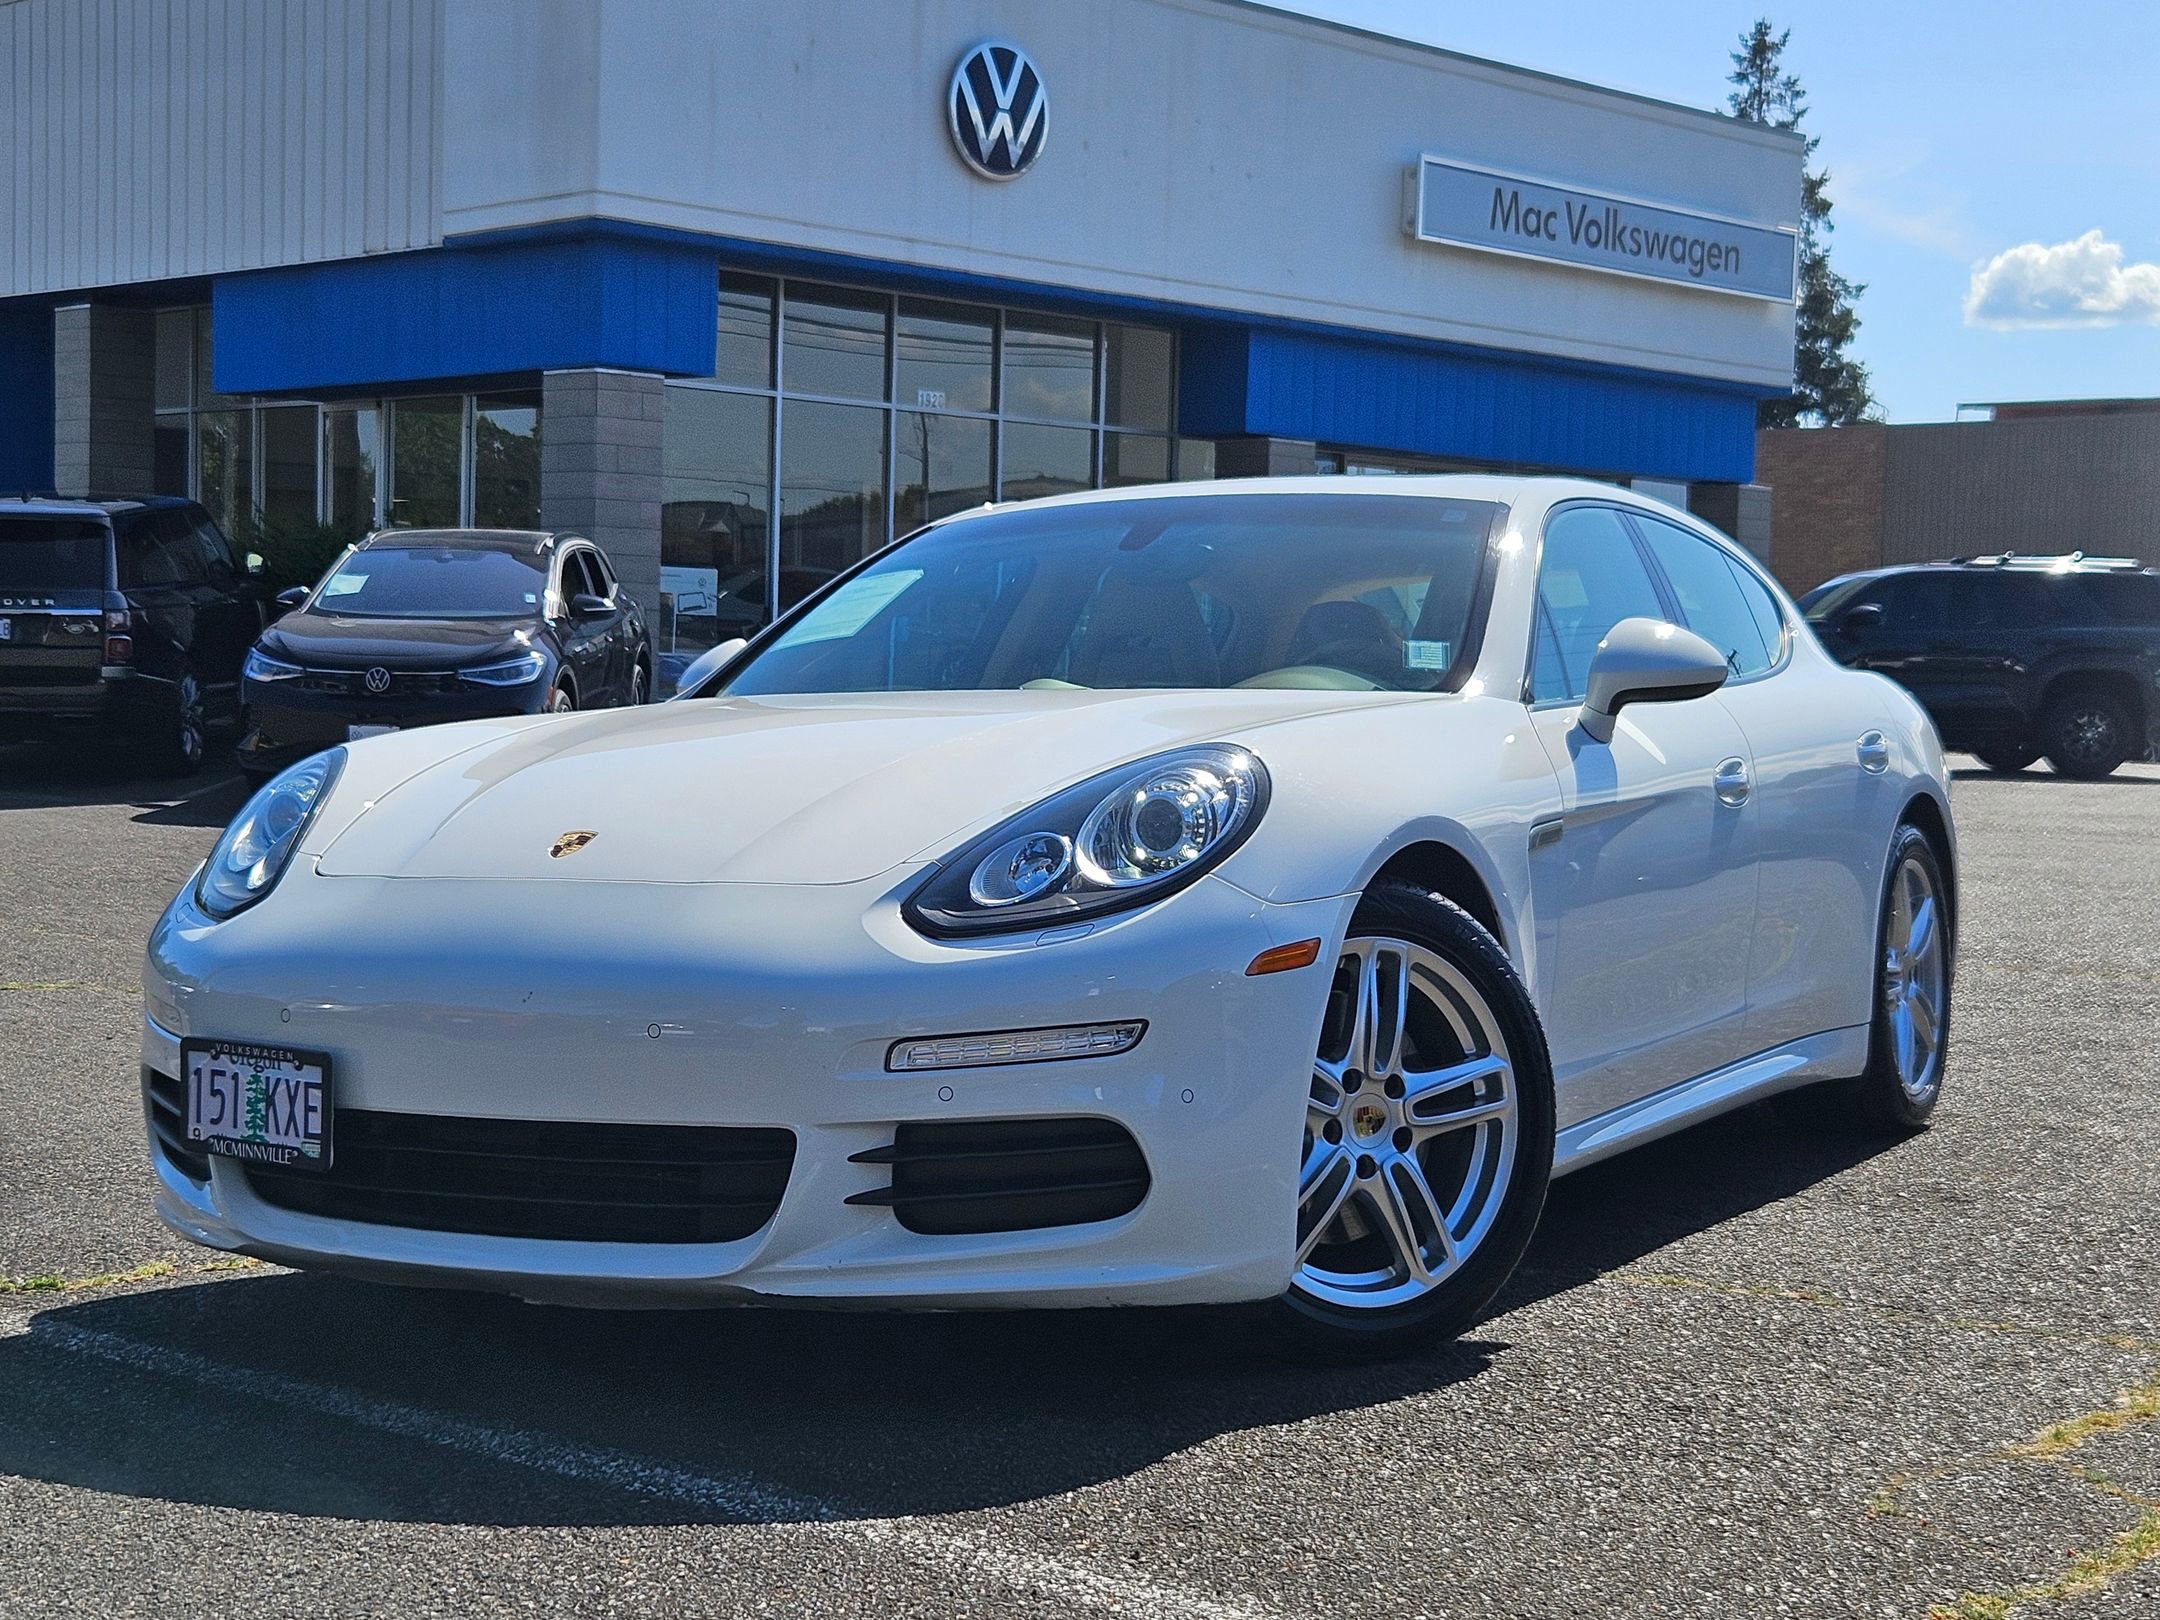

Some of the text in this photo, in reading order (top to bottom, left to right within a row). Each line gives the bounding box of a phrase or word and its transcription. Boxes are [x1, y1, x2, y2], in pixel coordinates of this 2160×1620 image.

[1490, 187, 1740, 277] Mac Volkswagen
[919, 392, 944, 408] 1920
[215, 1043, 294, 1060] VOLKSWAGEN
[194, 1067, 322, 1140] 151 KXE
[212, 1139, 293, 1164] MCMINNVILLE
